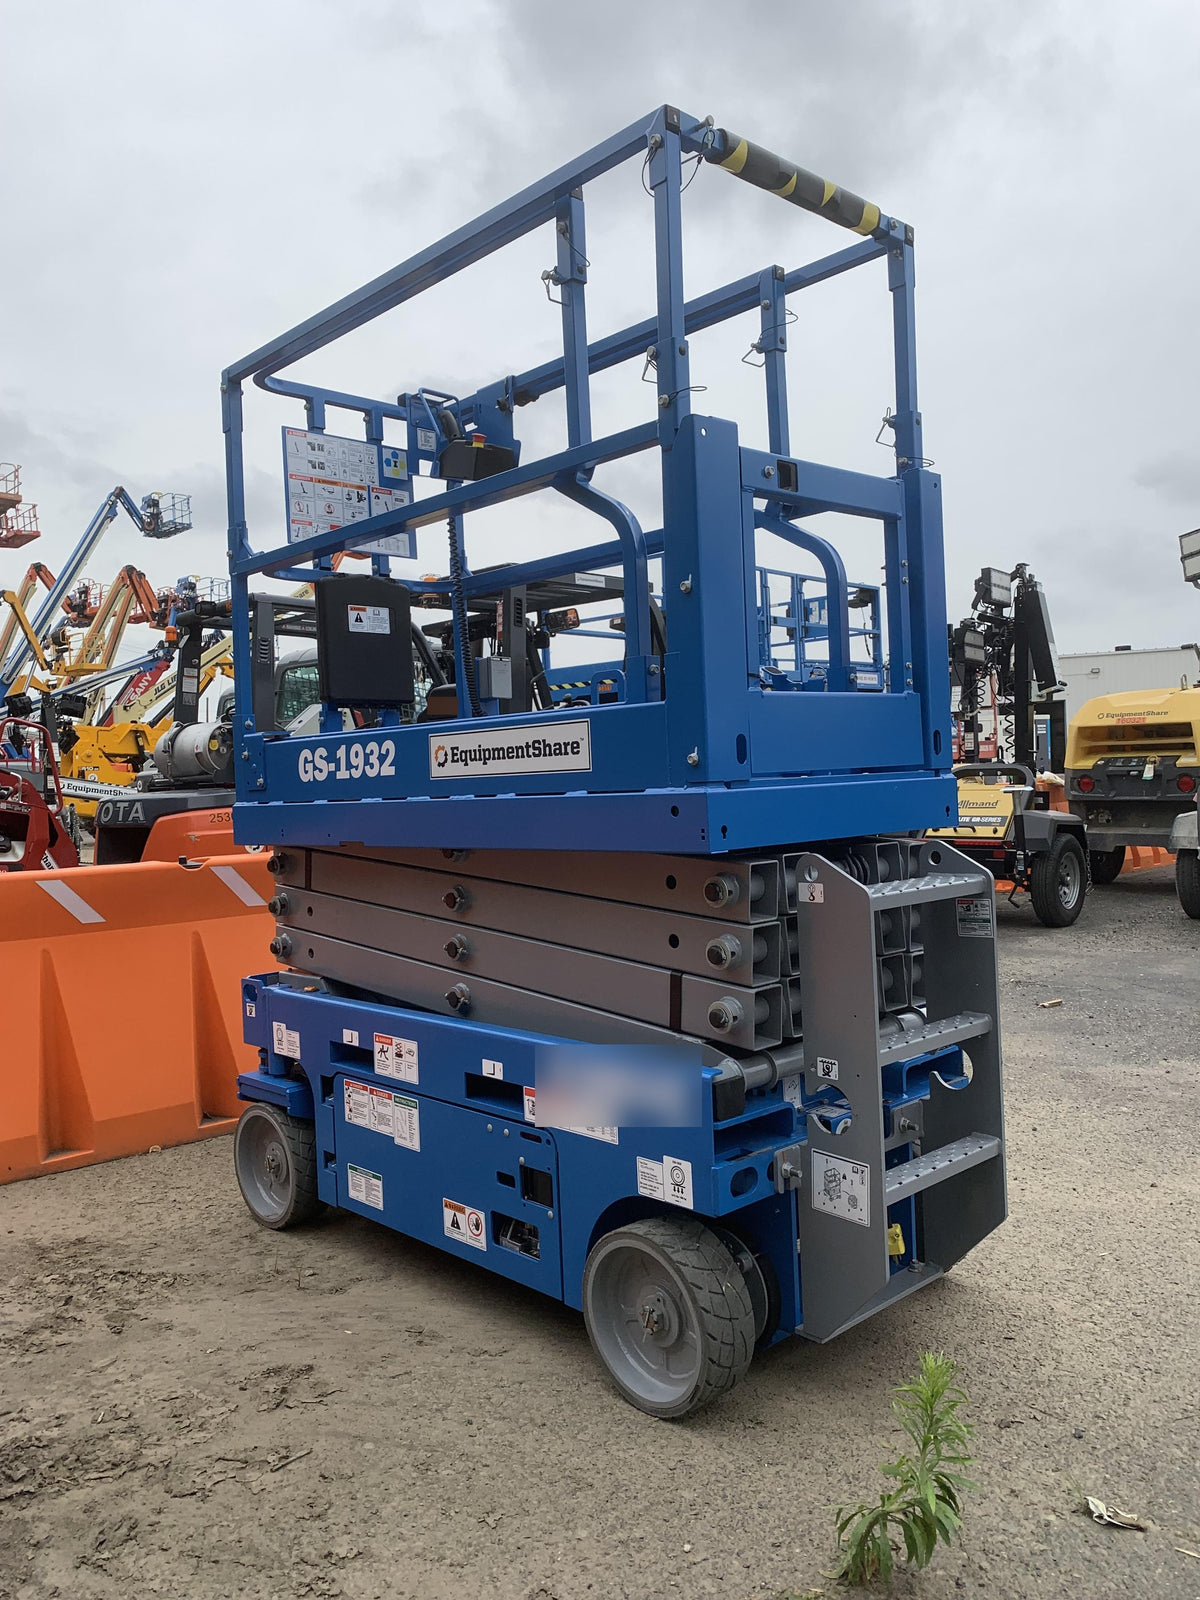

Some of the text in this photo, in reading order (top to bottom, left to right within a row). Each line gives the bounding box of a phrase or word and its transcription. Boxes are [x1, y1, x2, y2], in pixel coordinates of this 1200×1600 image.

[130, 672, 152, 703] SANY
[153, 682, 166, 696] JLG
[167, 675, 178, 686] LIF
[1105, 710, 1169, 719] EquipmentShare
[298, 739, 396, 782] GS-1932
[450, 739, 581, 766] EquipmentShare
[209, 812, 233, 824] 253
